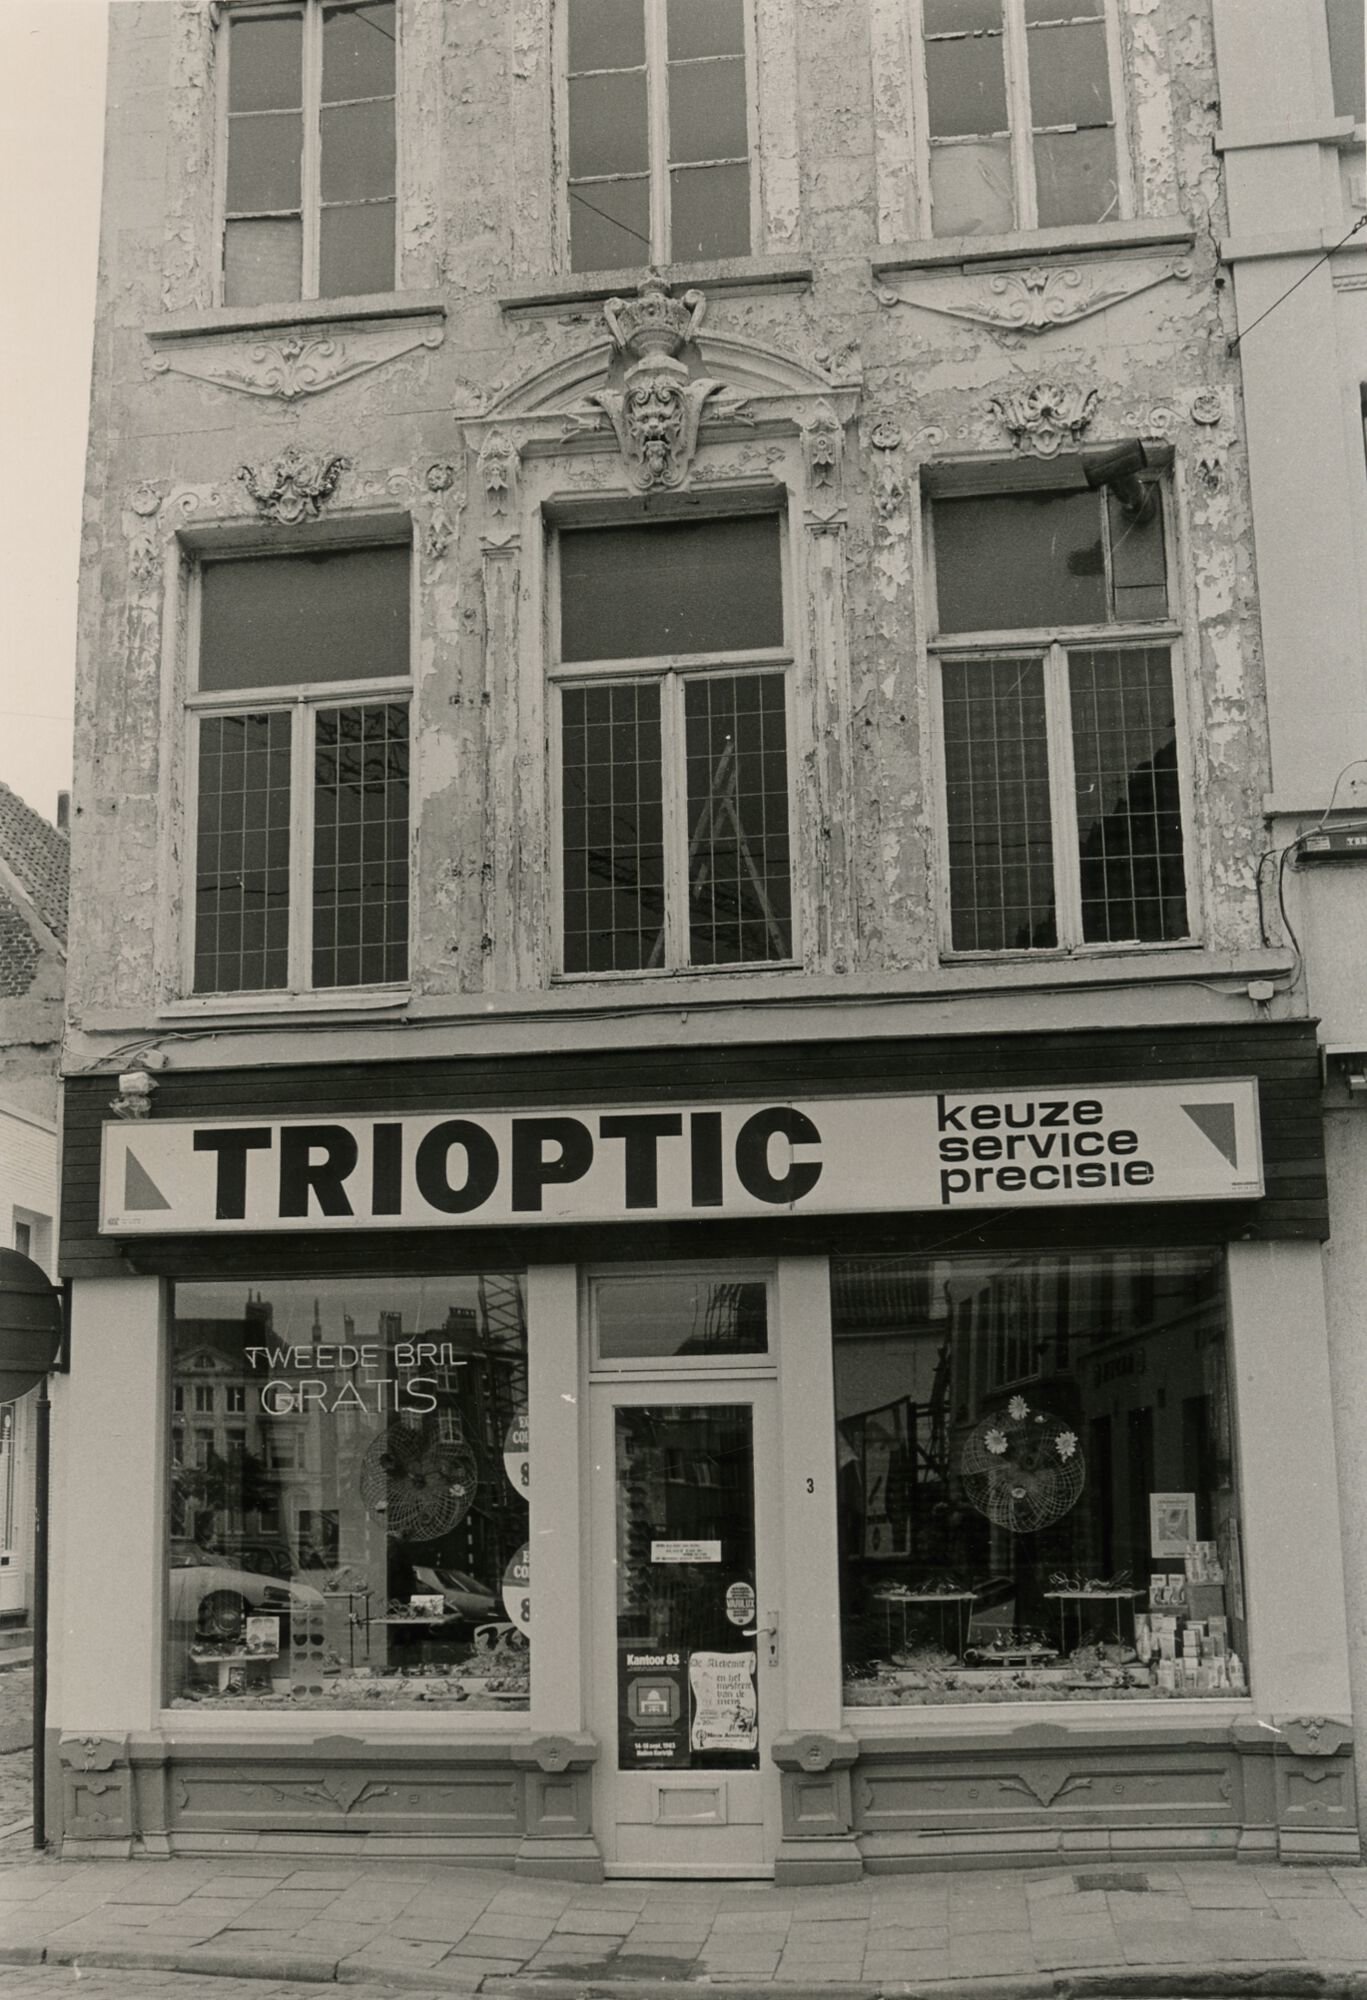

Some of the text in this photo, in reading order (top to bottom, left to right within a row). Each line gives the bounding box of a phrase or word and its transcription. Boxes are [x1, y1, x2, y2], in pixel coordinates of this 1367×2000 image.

[937, 1095, 1103, 1132] keuze
[193, 1106, 824, 1220] TRIOPTIC
[939, 1129, 1138, 1162] service
[940, 1159, 1154, 1204] precisie
[245, 1343, 467, 1368] TWEEDE BRIL
[261, 1378, 438, 1415] GRATIS
[806, 1477, 815, 1494] 3
[626, 1653, 680, 1666] Kantoor 83
